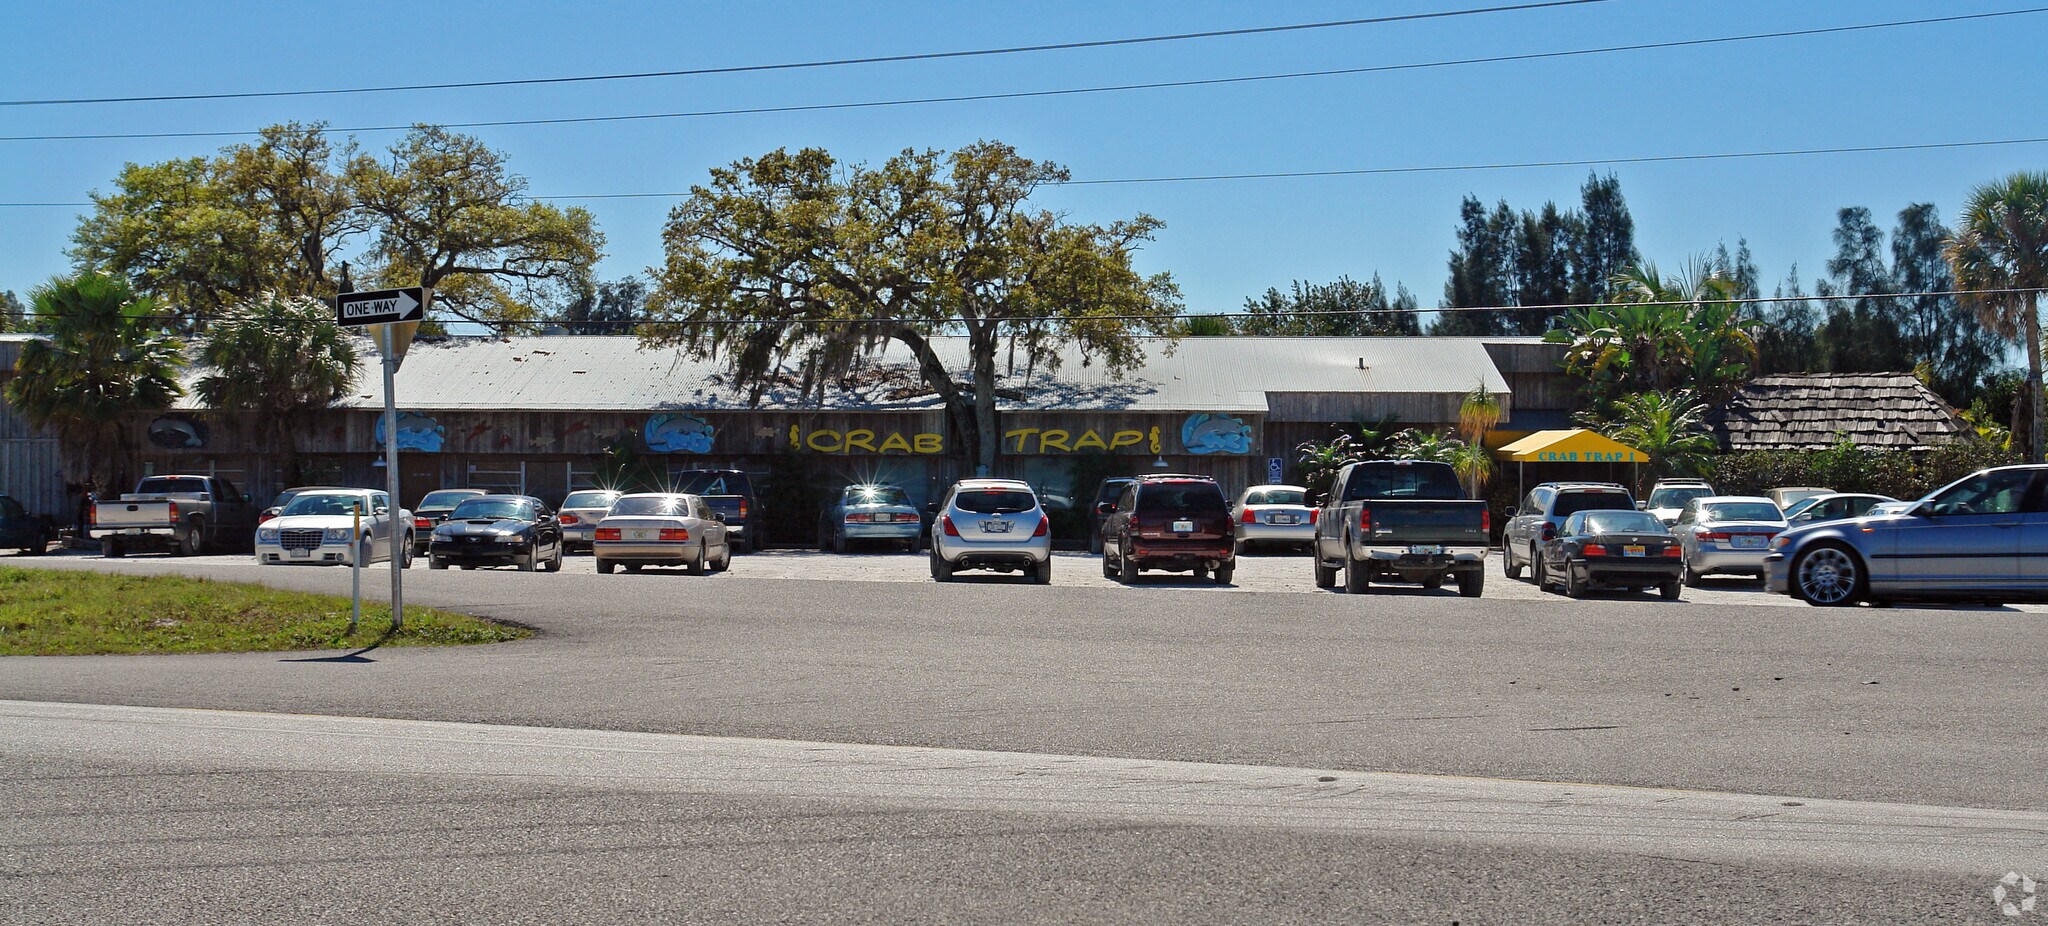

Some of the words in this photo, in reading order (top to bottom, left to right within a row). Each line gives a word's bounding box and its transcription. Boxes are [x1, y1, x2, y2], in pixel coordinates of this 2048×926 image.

[346, 302, 370, 316] ONE
[374, 299, 398, 313] WAY
[806, 429, 944, 454] CRAB
[1005, 428, 1144, 454] TRAP
[1538, 451, 1577, 461] CRAB
[1584, 451, 1623, 461] TRAP
